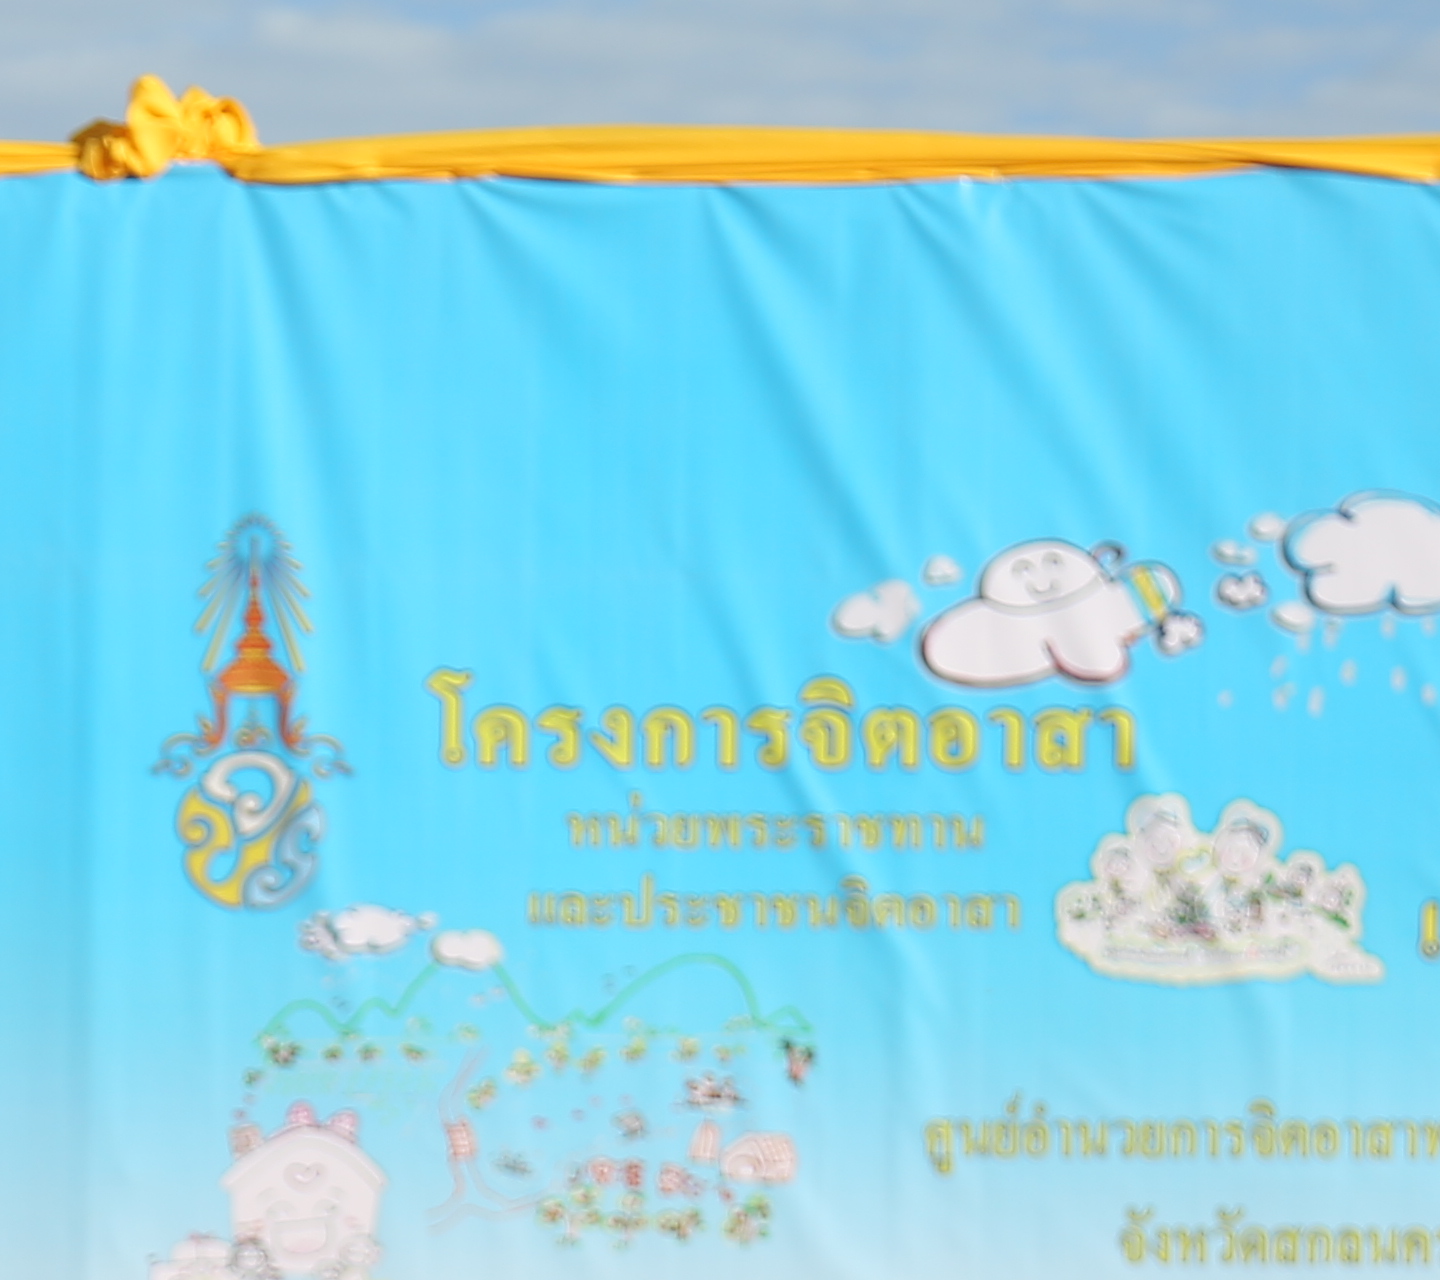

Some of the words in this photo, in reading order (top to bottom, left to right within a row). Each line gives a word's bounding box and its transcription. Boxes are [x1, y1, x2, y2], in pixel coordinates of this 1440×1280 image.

[426, 669, 1135, 770] โครงการจิตอาสา
[567, 791, 985, 848] หน่วยพระราชทาน
[527, 874, 1022, 929] และประชาชนจิตอาสา
